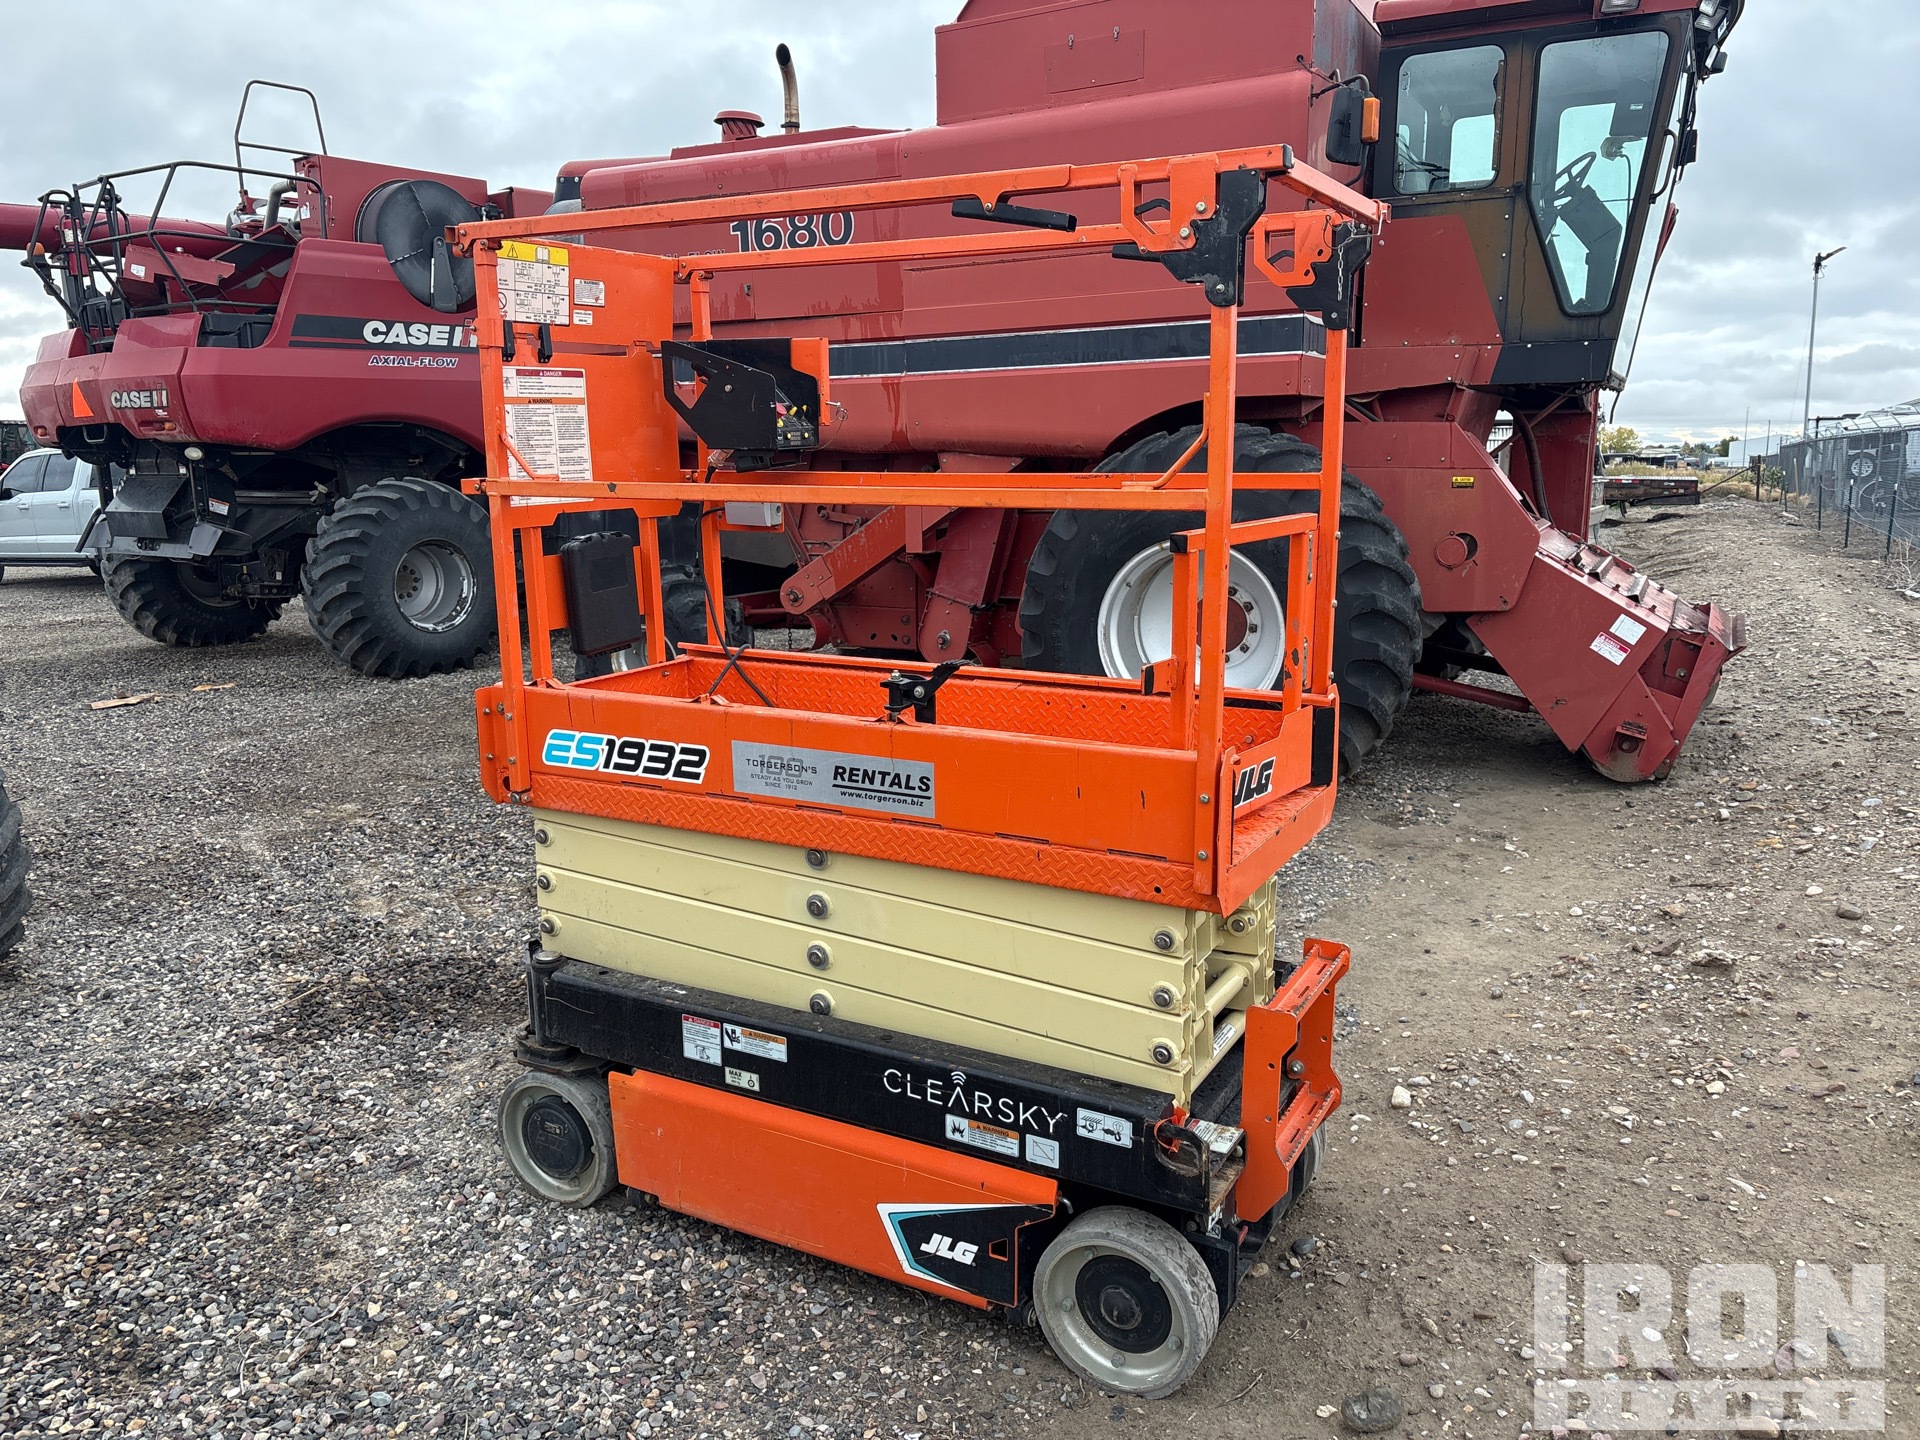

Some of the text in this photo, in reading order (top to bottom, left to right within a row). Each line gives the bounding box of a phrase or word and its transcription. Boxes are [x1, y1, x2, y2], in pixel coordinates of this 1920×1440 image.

[730, 212, 854, 253] 1680
[363, 320, 450, 346] CASE
[368, 355, 458, 368] AXIAL-FLOW
[111, 390, 151, 408] CASE
[543, 731, 709, 782] ES1932
[746, 758, 817, 774] TORGERSON'S
[765, 781, 782, 789] SINCE
[833, 765, 931, 793] RENTALS
[840, 790, 924, 807] www.torgerson.biz
[729, 1069, 742, 1077] MAX
[883, 1069, 1067, 1134] CLEARSKY
[983, 1124, 1010, 1137] WARNING
[920, 1232, 979, 1266] JLG
